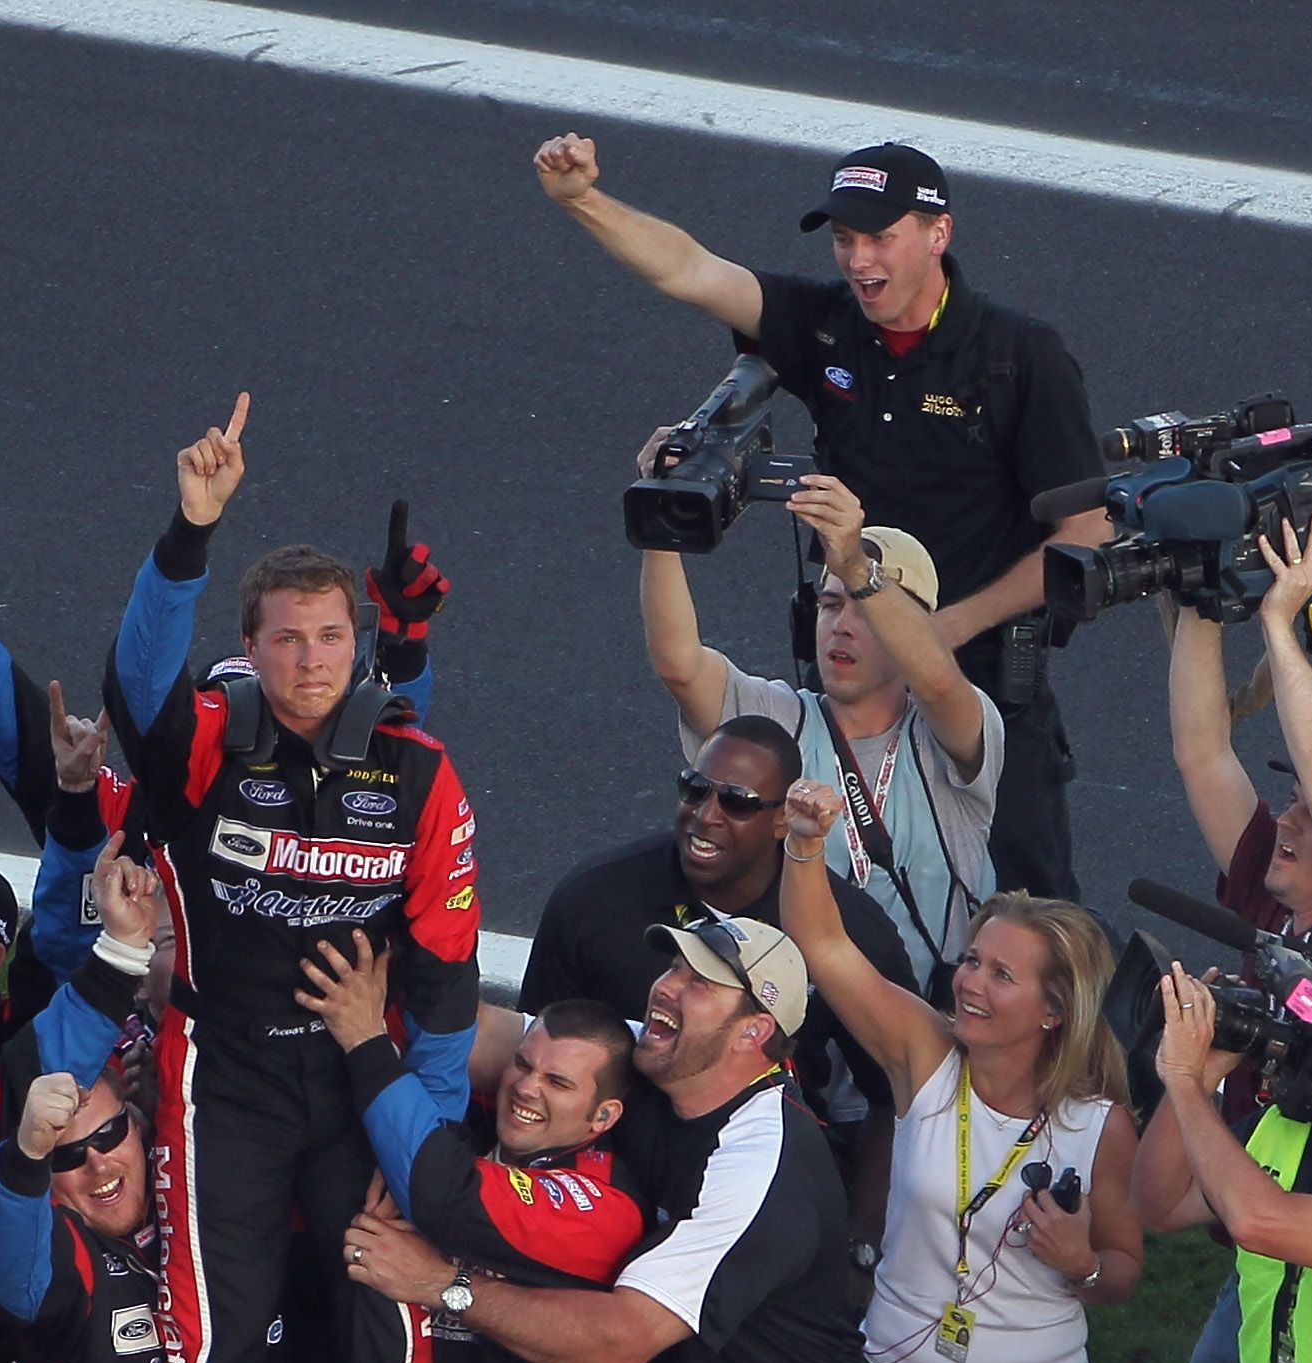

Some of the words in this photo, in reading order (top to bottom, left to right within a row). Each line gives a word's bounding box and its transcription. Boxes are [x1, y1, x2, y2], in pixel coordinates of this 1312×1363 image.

[355, 795, 388, 811] Ford
[845, 772, 874, 827] Canon
[347, 816, 373, 828] Drive
[271, 837, 406, 881] Motorcraft
